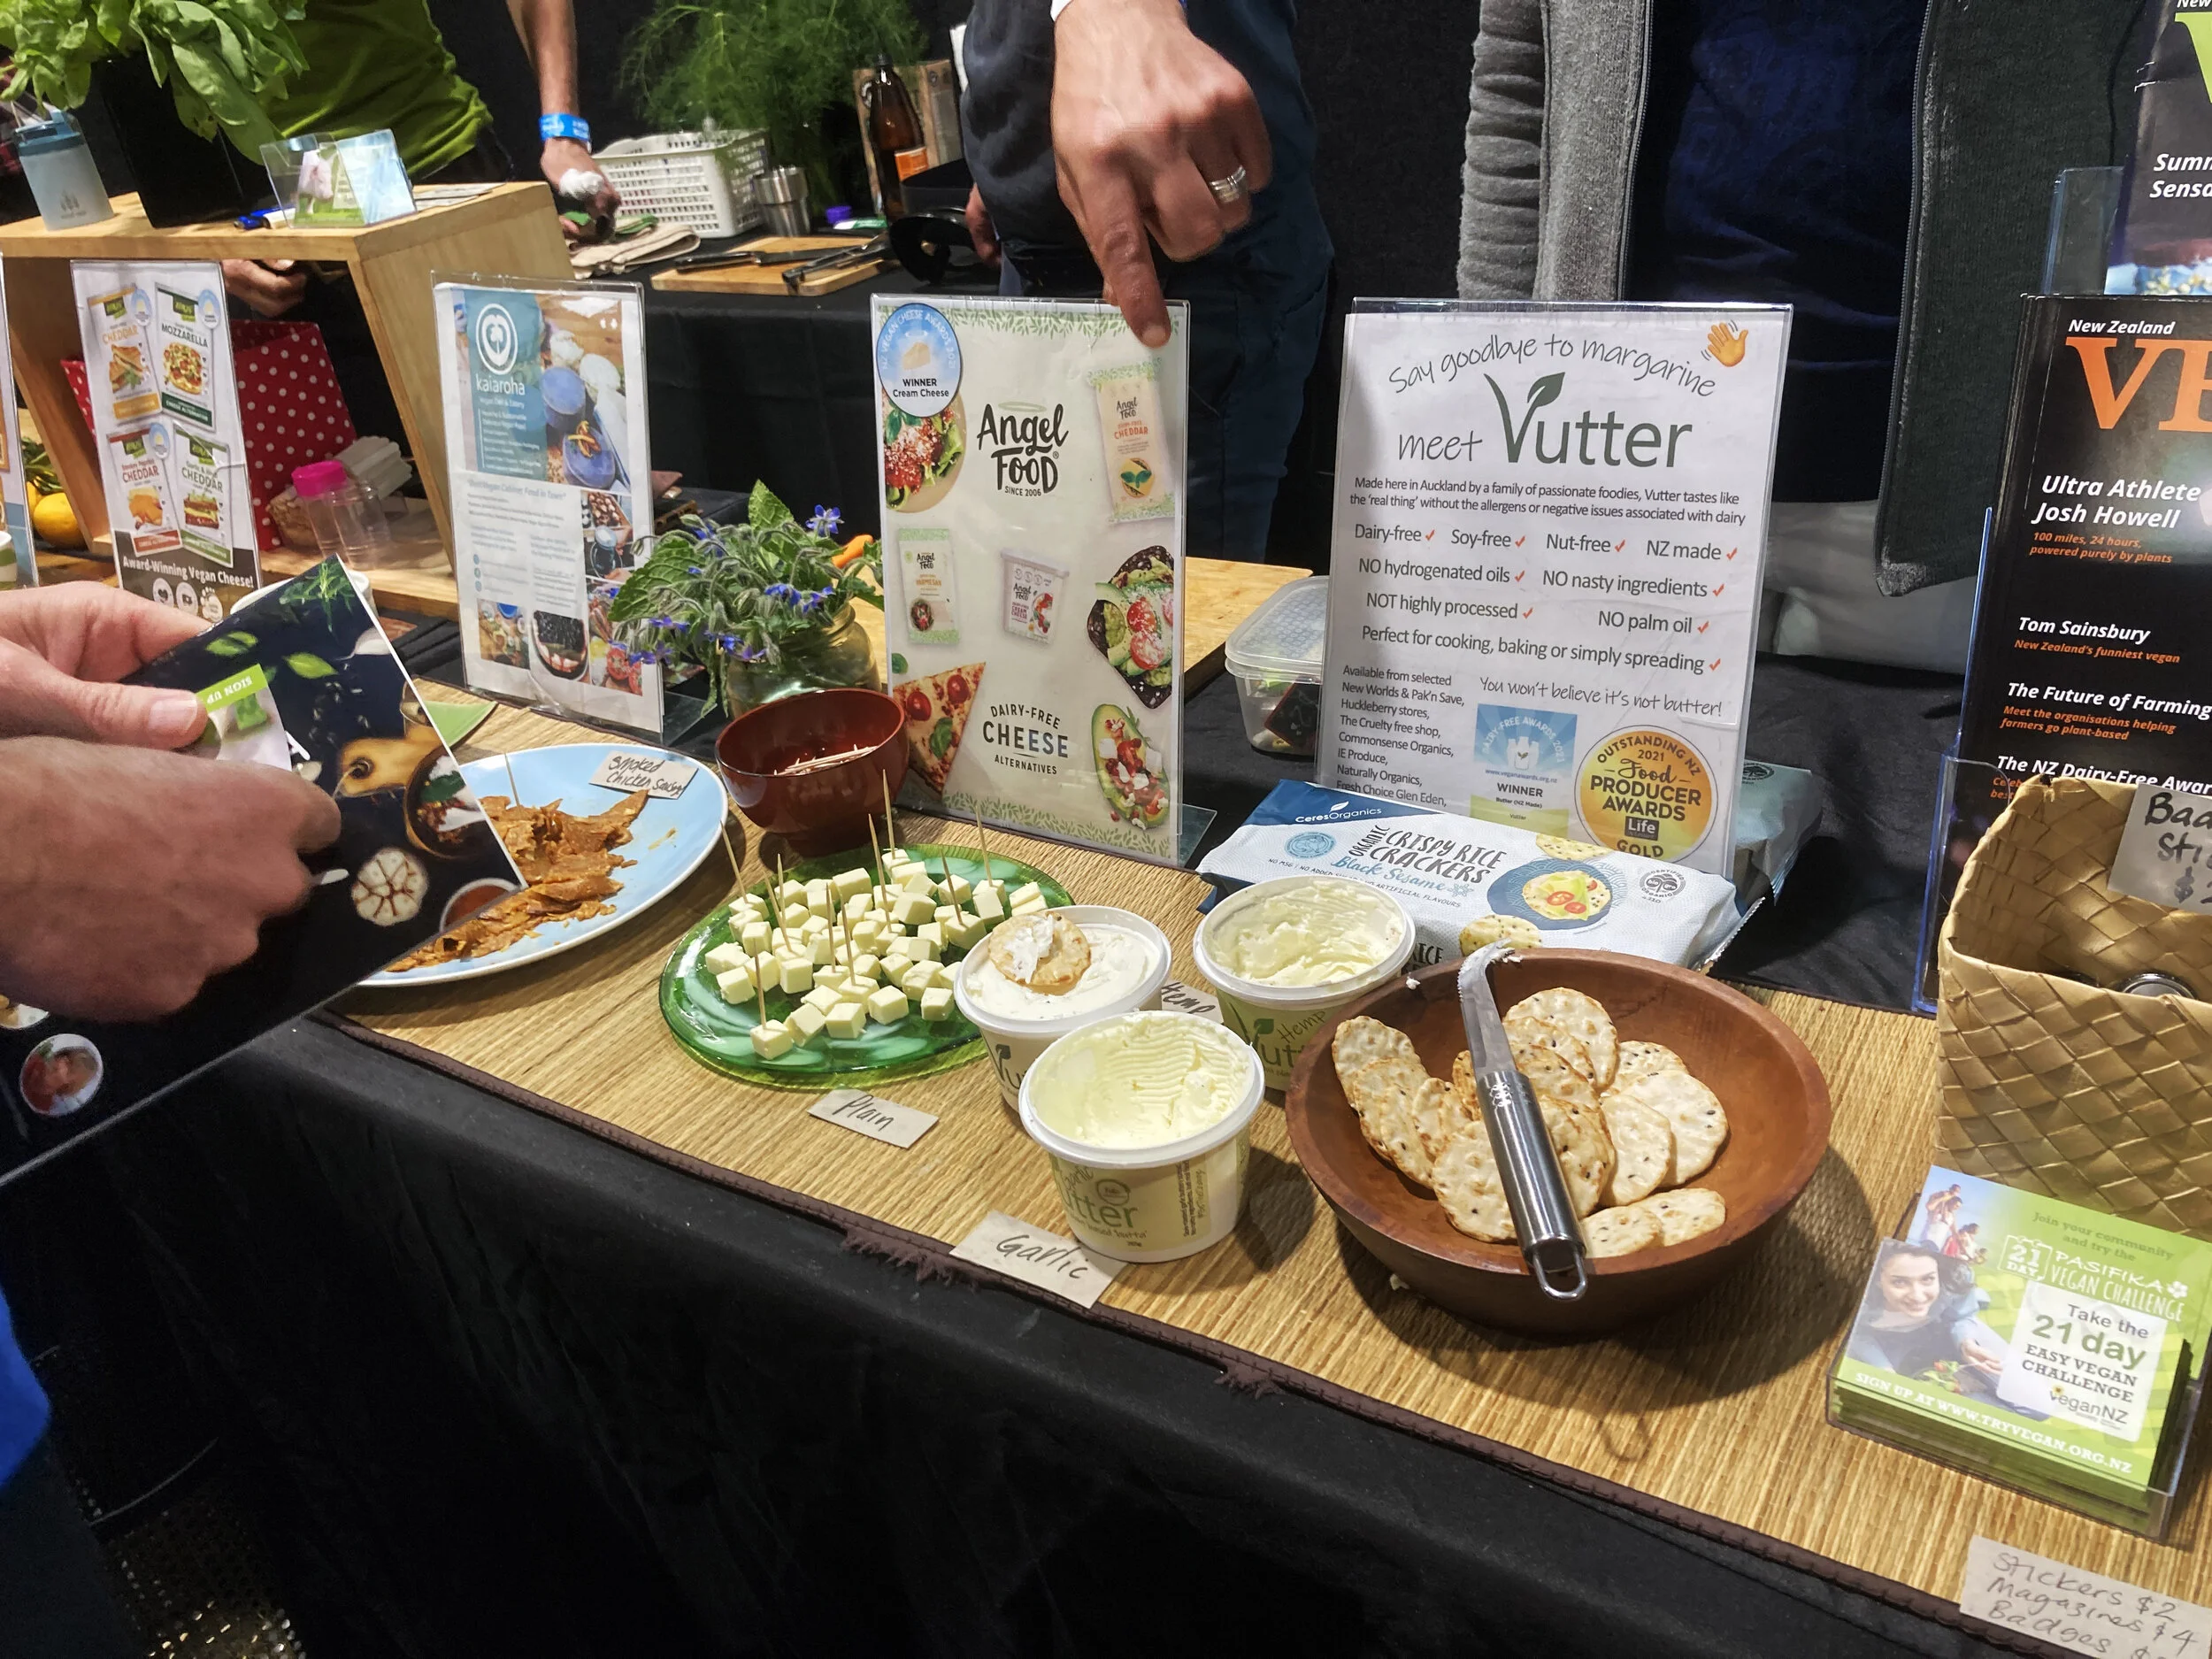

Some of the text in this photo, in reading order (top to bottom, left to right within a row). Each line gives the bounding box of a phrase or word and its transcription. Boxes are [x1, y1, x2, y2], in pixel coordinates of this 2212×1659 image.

[162, 323, 208, 348] MOZZARELLA
[2068, 319, 2176, 334] New Zealand
[1389, 334, 1716, 397] Say goodbye to margarine
[475, 373, 525, 396] kaiaroha
[977, 403, 1069, 455] Angel
[1114, 426, 1148, 439] CHEDDAR
[1398, 372, 1693, 469] meet Vutter
[122, 465, 158, 483] CHEDDAR
[181, 467, 223, 492] CHEDDAR
[1005, 486, 1041, 496] SINCE 2006
[1355, 477, 1740, 504] Made here Auckland family passionate foodies, Vutter tastes like
[2041, 475, 2201, 502] Ultra Athlete
[2031, 503, 2180, 529] Josh Howell
[1355, 524, 1722, 560] Dairy-free Soy-free Nut-free NZ made
[2030, 545, 2172, 564] powered purely plants
[2055, 534, 2142, 549] miles, hours,
[123, 556, 254, 588] Award-Winning Vegan Cheese!
[1358, 558, 1708, 598] NO hydrogenated oils NO nasty ingredients
[1366, 593, 1693, 634] NOT highly processed NO palm oil
[2018, 617, 2151, 645] Tom Sainsbury
[1362, 626, 1705, 674] Perfect for cooking, baking simply spreading
[2014, 639, 2181, 664] New Zealand's funniest vegan
[207, 676, 252, 703] SIGN UP
[1342, 682, 1465, 707] New Worlds Pak'n Save,
[1479, 677, 1722, 718] You won't believe it's not butter!
[2007, 682, 2212, 721] The Future of Farming
[990, 704, 1061, 729] DAIRY-FREE
[1340, 715, 1440, 739] The Cruelty free shop,
[1523, 717, 1556, 740] AWARDS
[2003, 705, 2177, 735] Meet the organisations helping
[983, 720, 1069, 758] CHEESE
[1339, 732, 1454, 757] Commonsense Organics,
[609, 756, 665, 772] Smoked
[995, 754, 1056, 774] ALTERNATIVES
[1597, 735, 1701, 776] OUTSTANDING NZ
[1638, 749, 1664, 761] 2021
[1997, 756, 2028, 772] The
[2032, 760, 2059, 776] NZ
[1618, 758, 1677, 784] Food
[1363, 785, 1394, 798] Choice
[1396, 789, 1417, 802] Glen
[1420, 793, 1447, 807] Eden,
[1497, 782, 1543, 797] WINNER
[1591, 775, 1701, 806] PRODUCER
[1602, 795, 1686, 821] AWARDS
[1628, 818, 1656, 834] Life
[1348, 826, 1390, 856] ORGANIC
[1386, 830, 1507, 870] CRISPY RICE
[1617, 840, 1663, 858] GOLD
[1331, 856, 1446, 891] Black Sesame
[1370, 847, 1490, 884] CRACKERS
[1376, 883, 1460, 908] ARTIFICIAL FLAVOURS
[1162, 981, 1216, 1014] Hemp
[1277, 1010, 1325, 1043] Hemp
[832, 1094, 894, 1132] Plain
[996, 1235, 1088, 1279] Garlic
[2008, 1245, 2041, 1264] 21
[2008, 1262, 2037, 1276] DAY
[2056, 1250, 2164, 1294] PASIFIKA
[2052, 1265, 2184, 1322] VEGAN CHALLENGE
[2069, 1304, 2148, 1339] Take the
[2032, 1315, 2147, 1371] 21 day
[2025, 1344, 2138, 1386] EASY VEGAN
[2022, 1359, 2133, 1404] CHALLENGE
[1855, 1372, 1890, 1393] SIGN
[1894, 1385, 1913, 1399] UP
[1915, 1392, 1934, 1406] AT
[1937, 1399, 2132, 1474] WWW.TRYVEGAN.ORG.NZ
[1993, 1552, 2123, 1605] Stickers
[1987, 1577, 2141, 1632] Magazines
[1988, 1600, 2111, 1653] Badges
